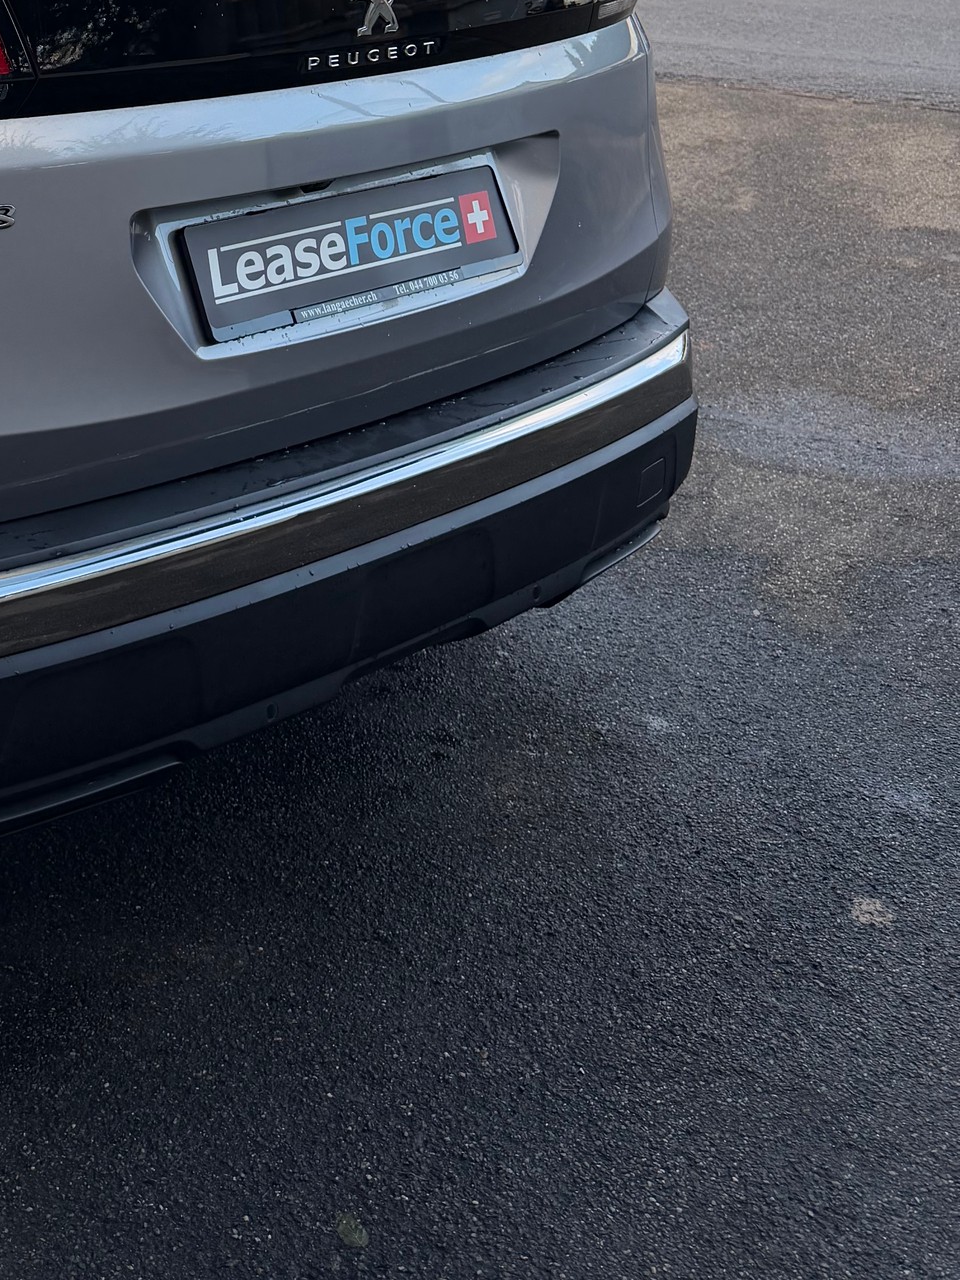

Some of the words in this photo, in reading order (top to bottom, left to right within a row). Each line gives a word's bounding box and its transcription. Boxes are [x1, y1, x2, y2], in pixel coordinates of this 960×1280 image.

[307, 41, 435, 71] PEUGEOT
[207, 207, 461, 299] LeaseForce
[300, 291, 378, 319] www.langaecher.ch
[392, 284, 409, 296] Tel.
[409, 280, 424, 291] 044
[425, 276, 438, 287] 700
[439, 274, 448, 285] 03
[449, 271, 459, 282] 56
